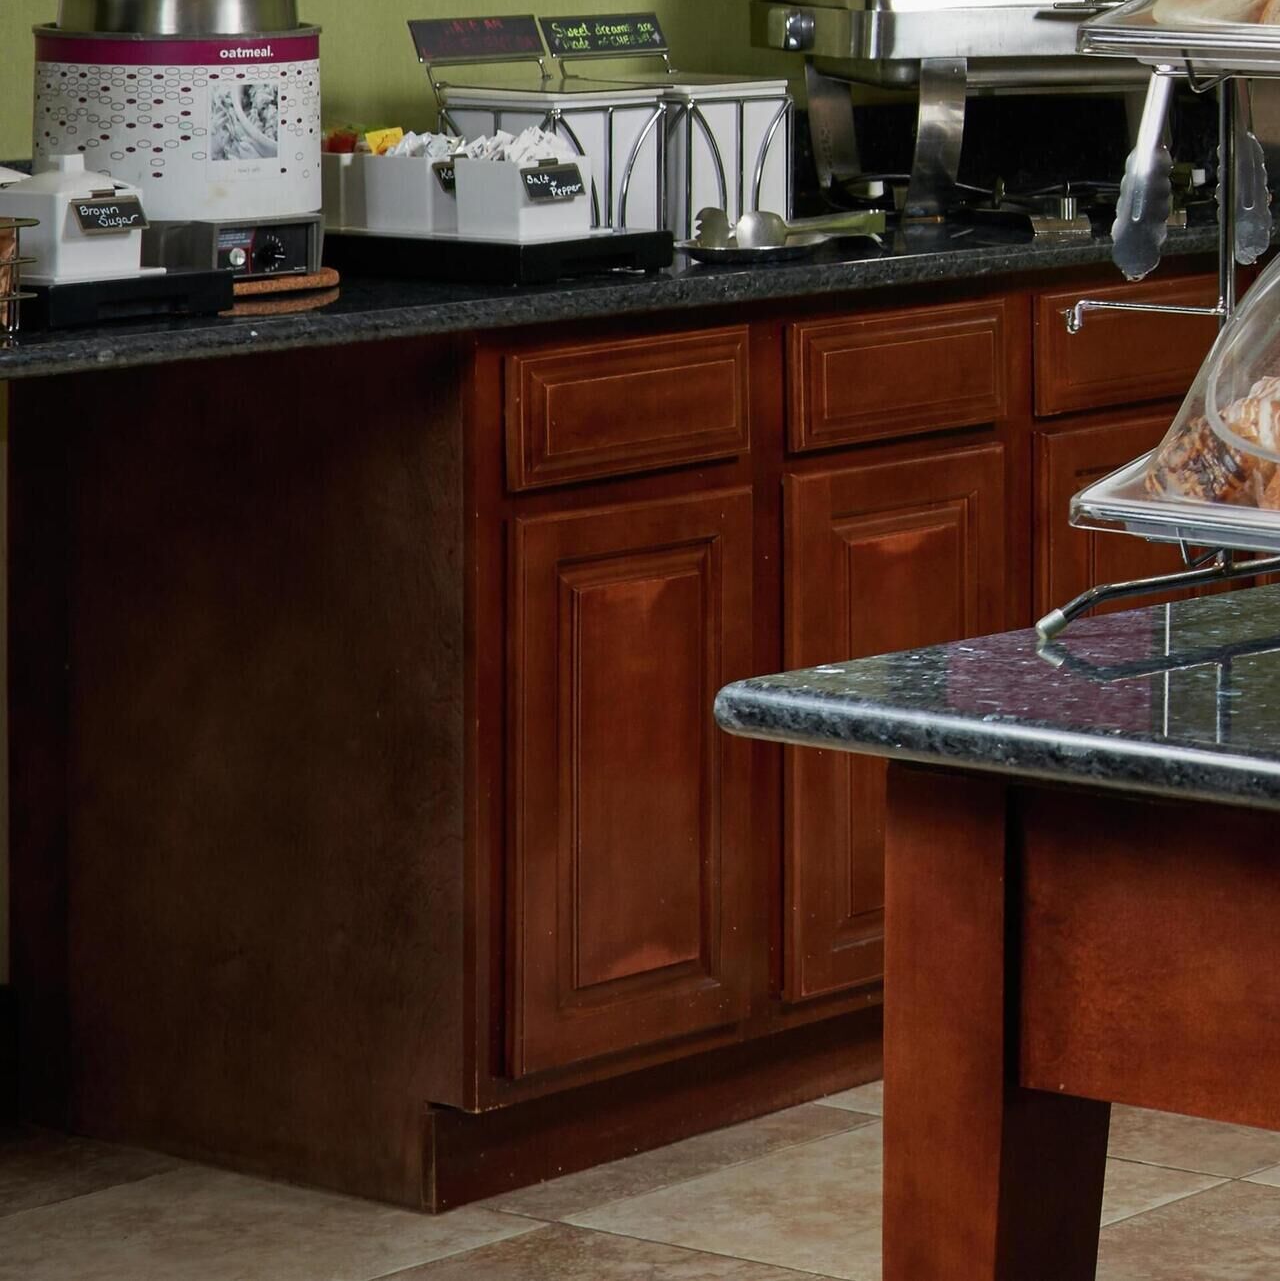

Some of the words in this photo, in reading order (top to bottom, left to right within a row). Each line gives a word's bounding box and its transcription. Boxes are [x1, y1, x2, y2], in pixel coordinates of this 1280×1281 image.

[219, 45, 274, 59] oatmeal.
[526, 174, 549, 184] Salt
[549, 183, 581, 197] Pepper
[79, 205, 119, 217] Brown
[98, 215, 139, 228] Sugar
